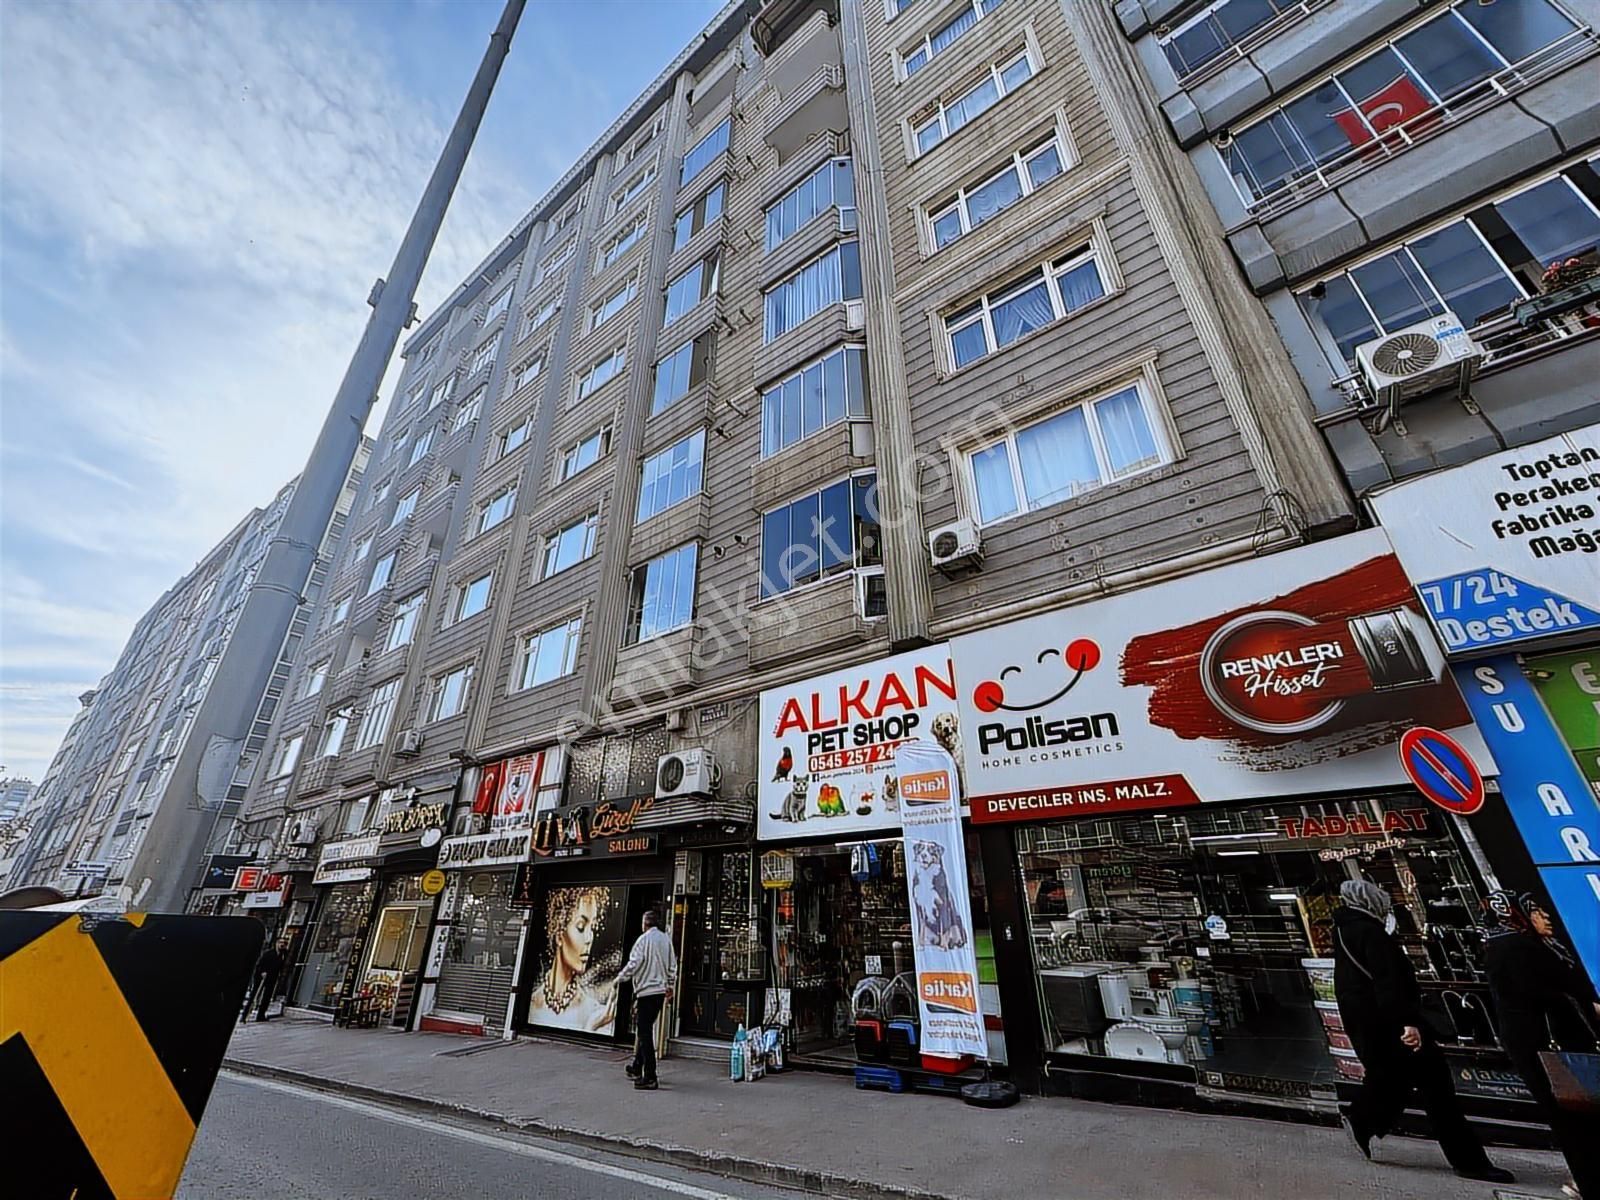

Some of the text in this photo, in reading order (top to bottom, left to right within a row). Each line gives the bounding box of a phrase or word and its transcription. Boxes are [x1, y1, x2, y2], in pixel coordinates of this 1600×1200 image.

[1422, 572, 1518, 613] 7/24
[1438, 599, 1581, 647] Destek
[775, 658, 957, 738] ALKAN
[1244, 663, 1341, 697] Hisset
[808, 713, 920, 755] PET SHOP
[978, 713, 1120, 754] Polisan
[810, 743, 895, 772] 0545 257 24
[982, 742, 1124, 769] HOME COSMETICS
[1115, 782, 1173, 800] MALZ.
[608, 836, 650, 853] SALONU
